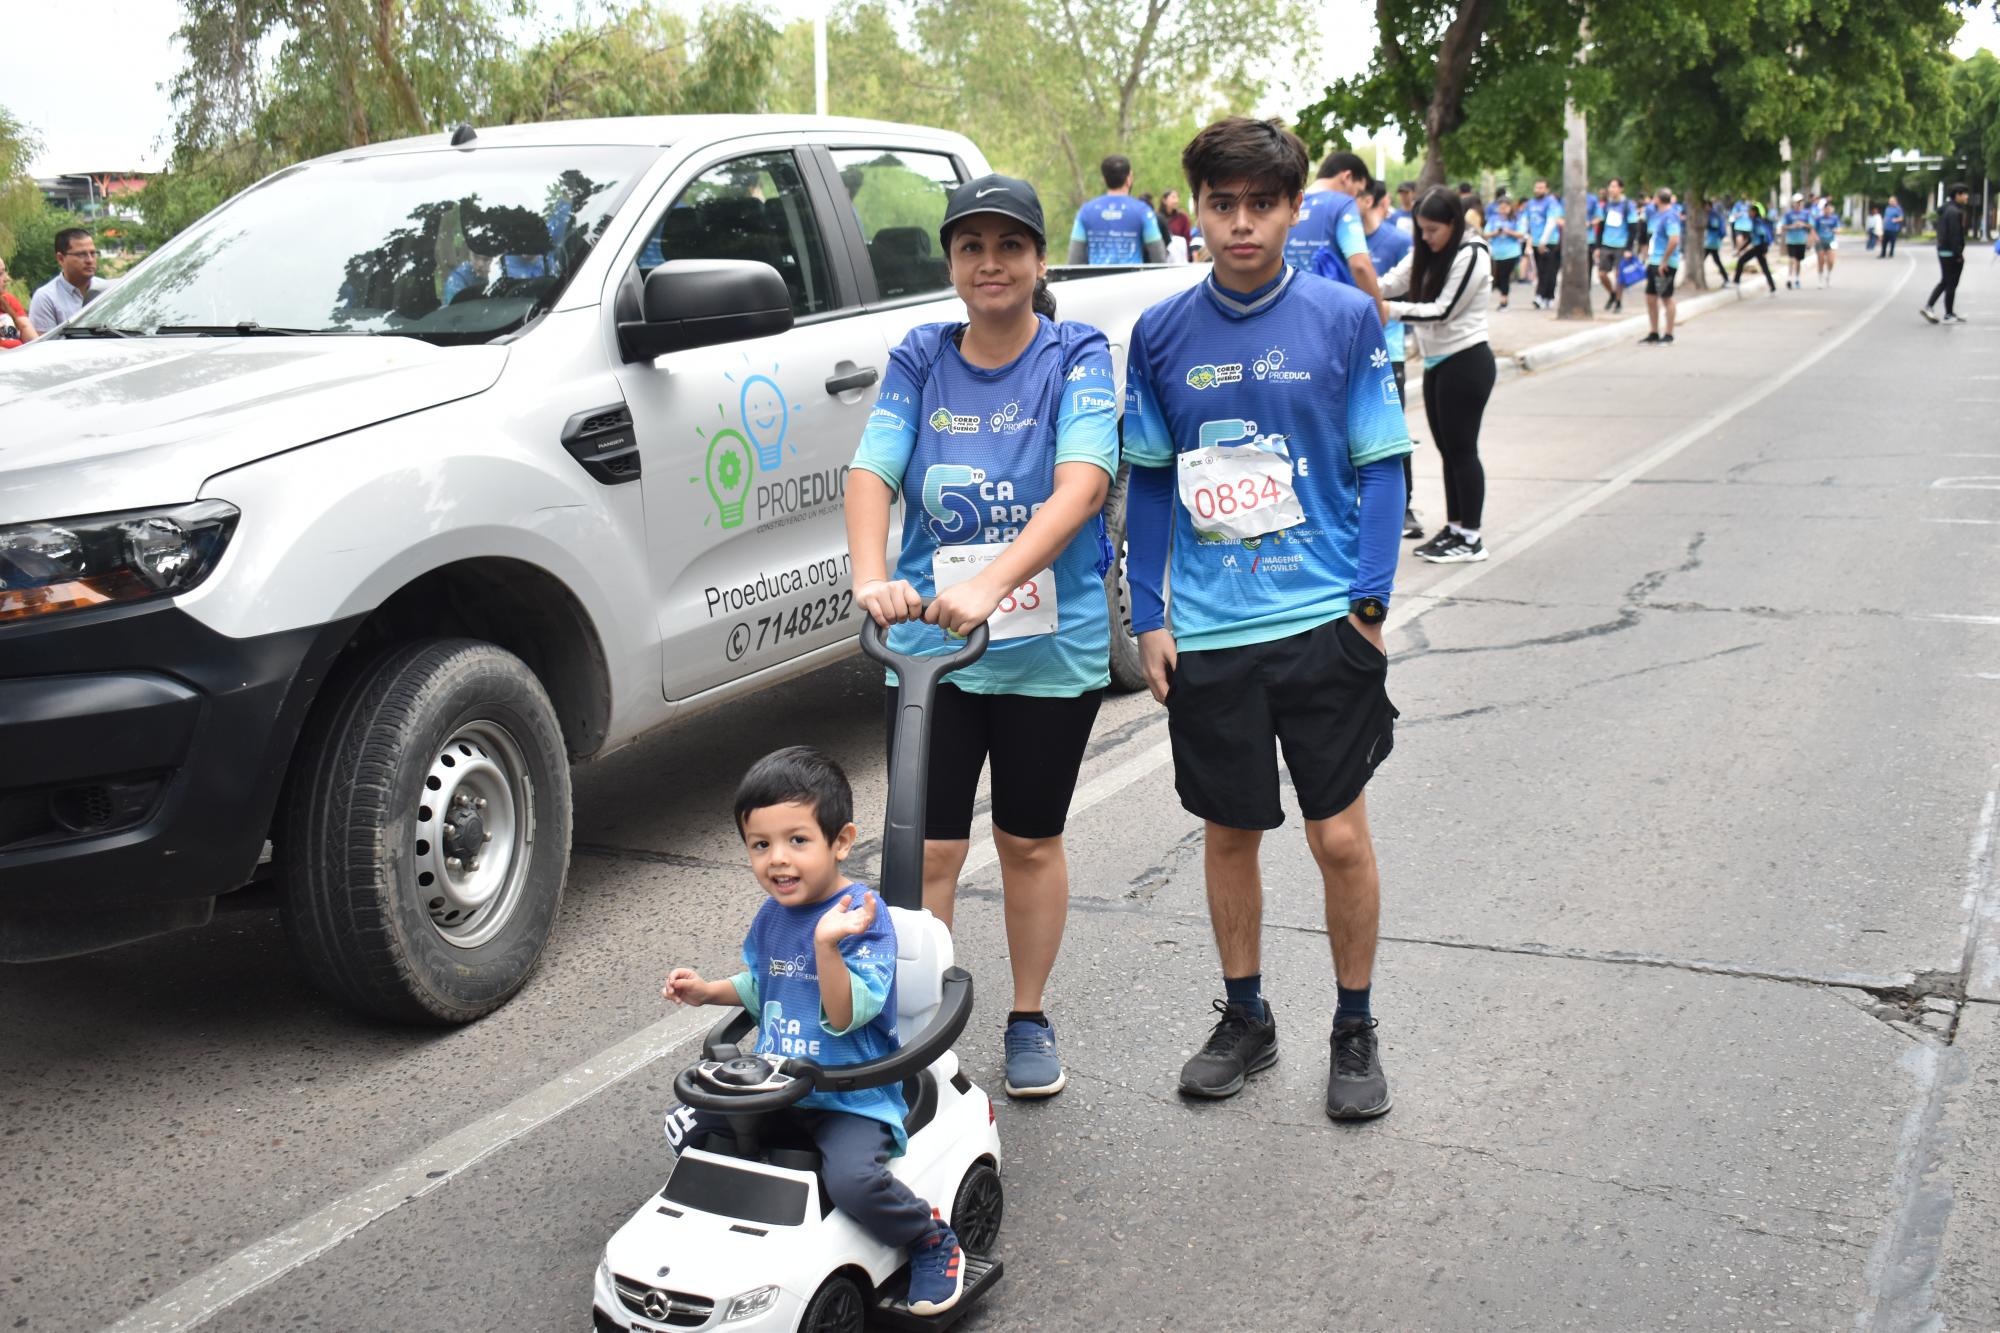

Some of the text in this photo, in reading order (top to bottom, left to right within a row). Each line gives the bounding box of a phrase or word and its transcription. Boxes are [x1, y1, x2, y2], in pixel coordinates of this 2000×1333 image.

[1269, 371, 1311, 380] PROEDUCA
[922, 464, 982, 545] 5
[980, 480, 1014, 501] CA
[1194, 474, 1282, 519] 0834
[756, 588, 854, 652] 7148232
[782, 1038, 820, 1056] RRE
